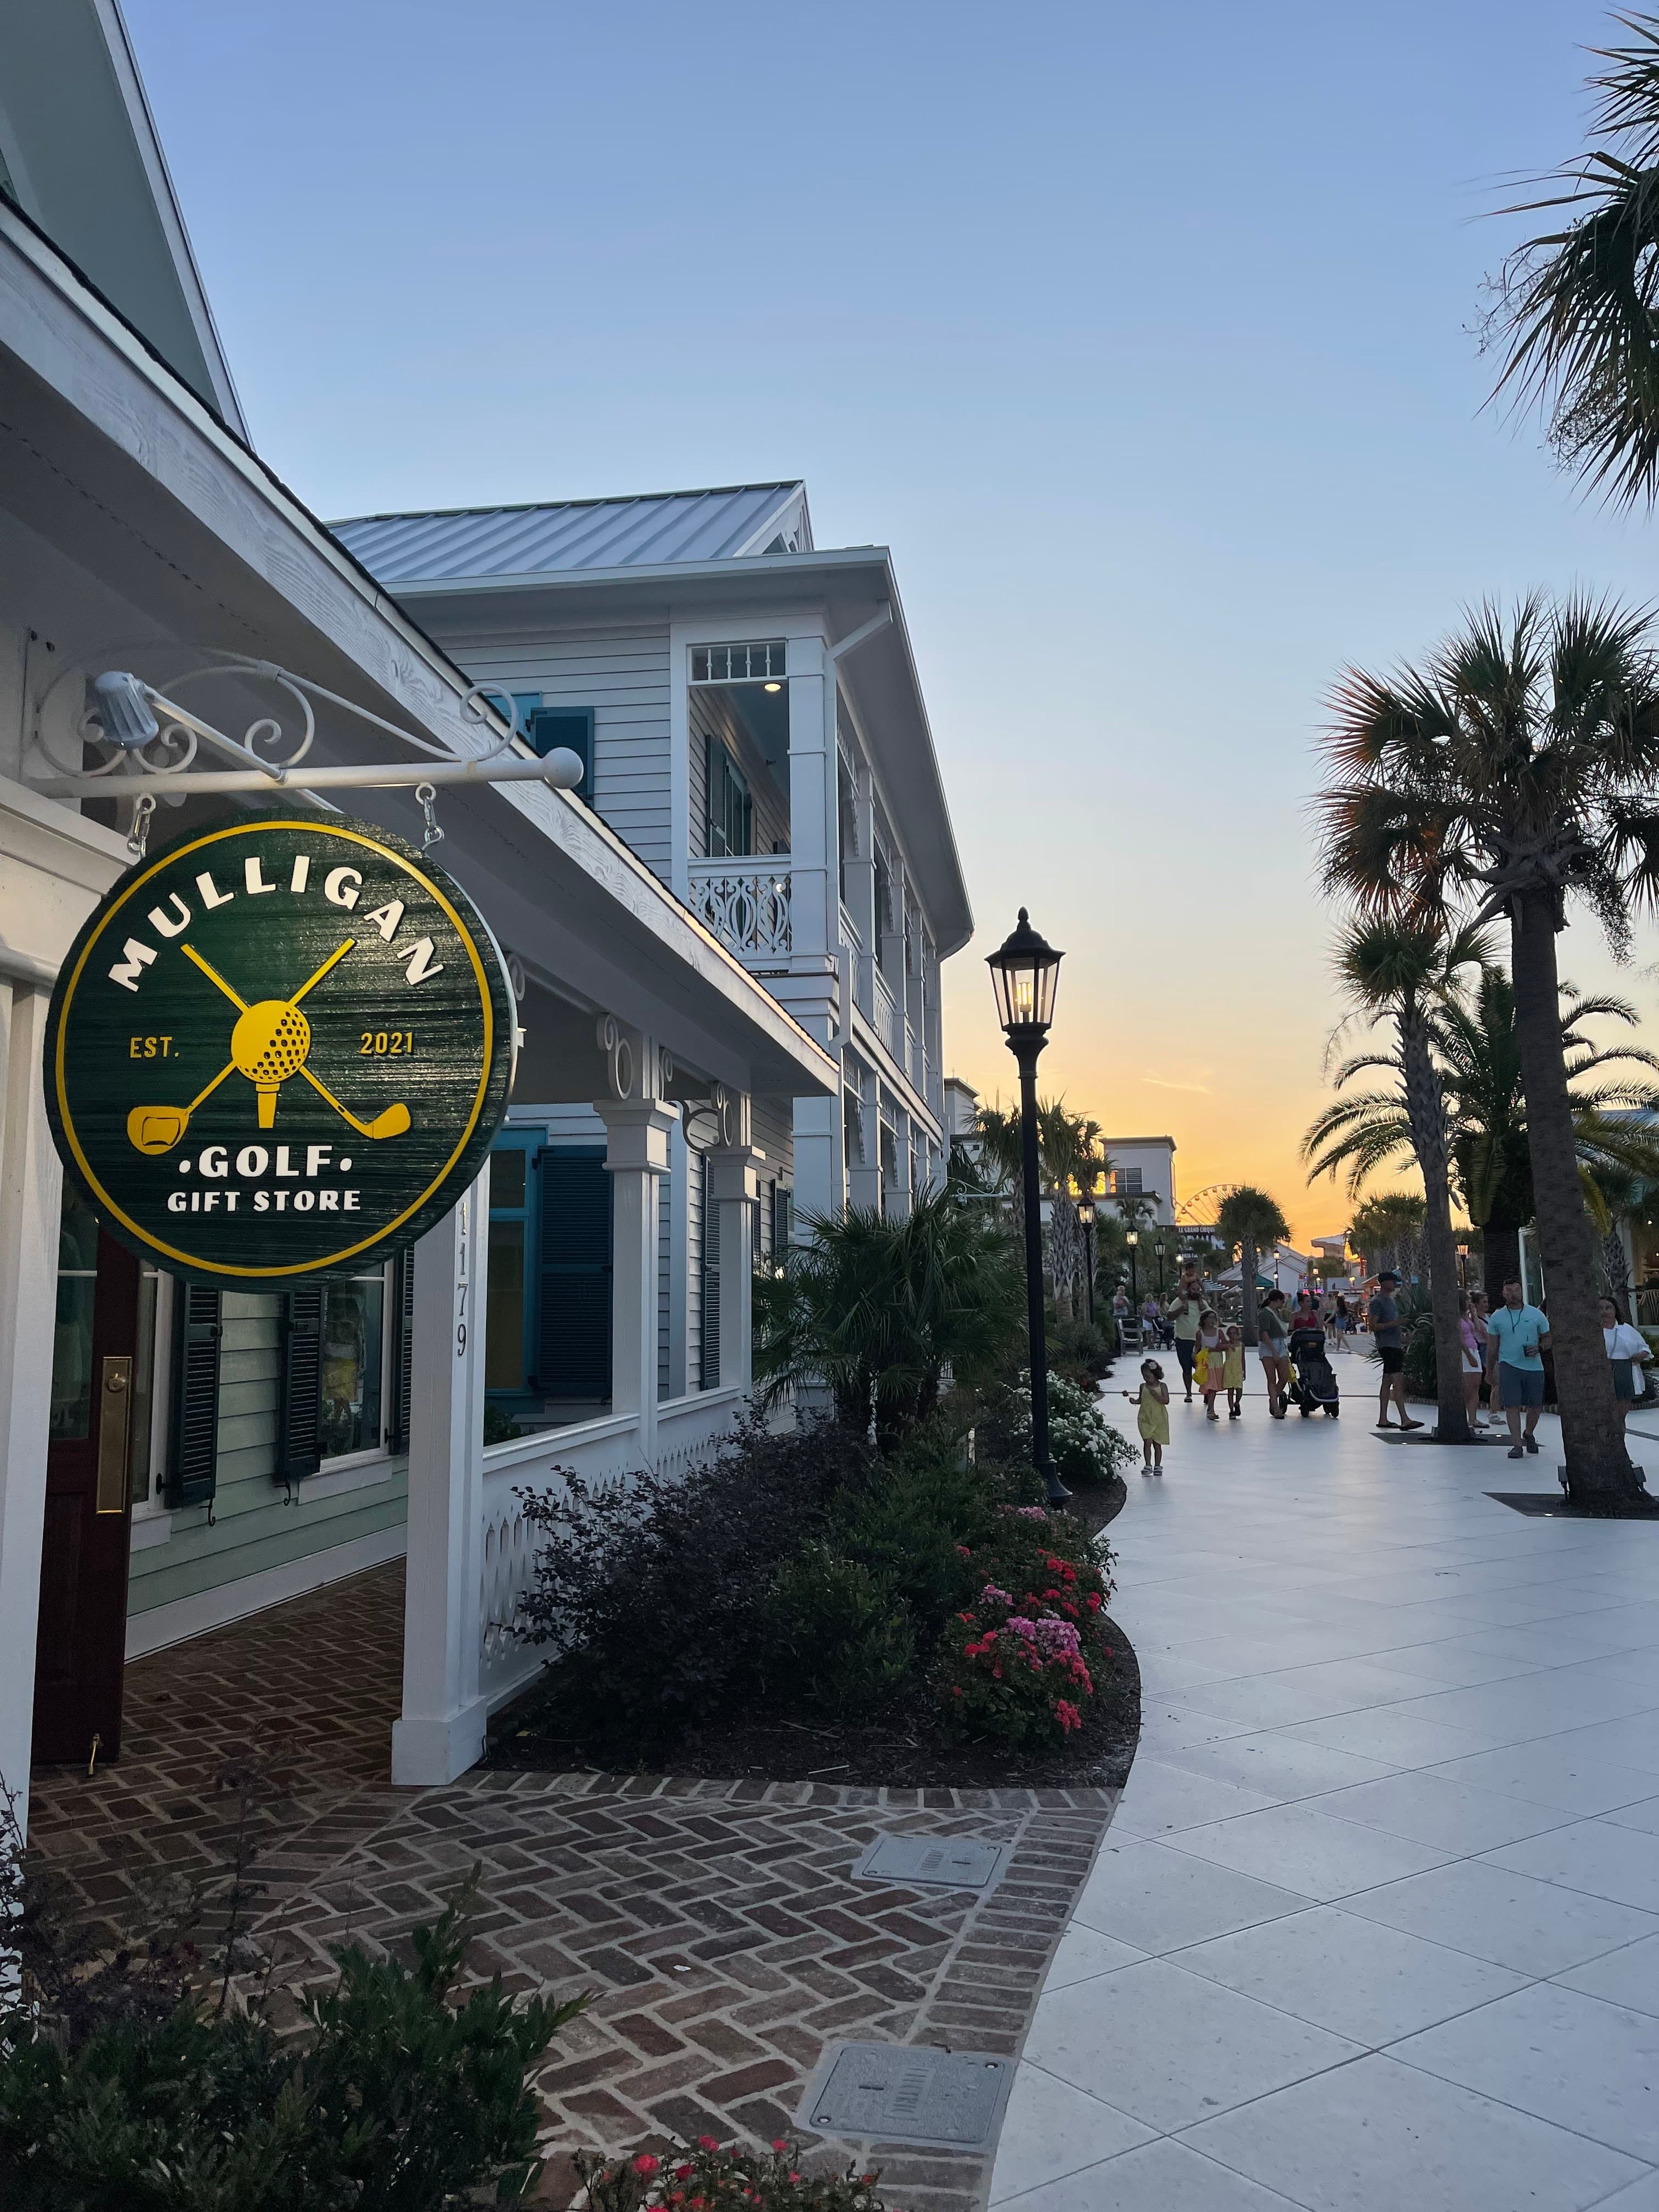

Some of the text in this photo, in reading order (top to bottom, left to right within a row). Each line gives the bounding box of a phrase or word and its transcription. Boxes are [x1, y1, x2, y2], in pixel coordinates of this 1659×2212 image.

[108, 855, 444, 992] MULLIGAN
[129, 1031, 414, 1058] EST. 2021
[198, 1145, 332, 1177] GOLF
[167, 1190, 361, 1212] GIFT STORE
